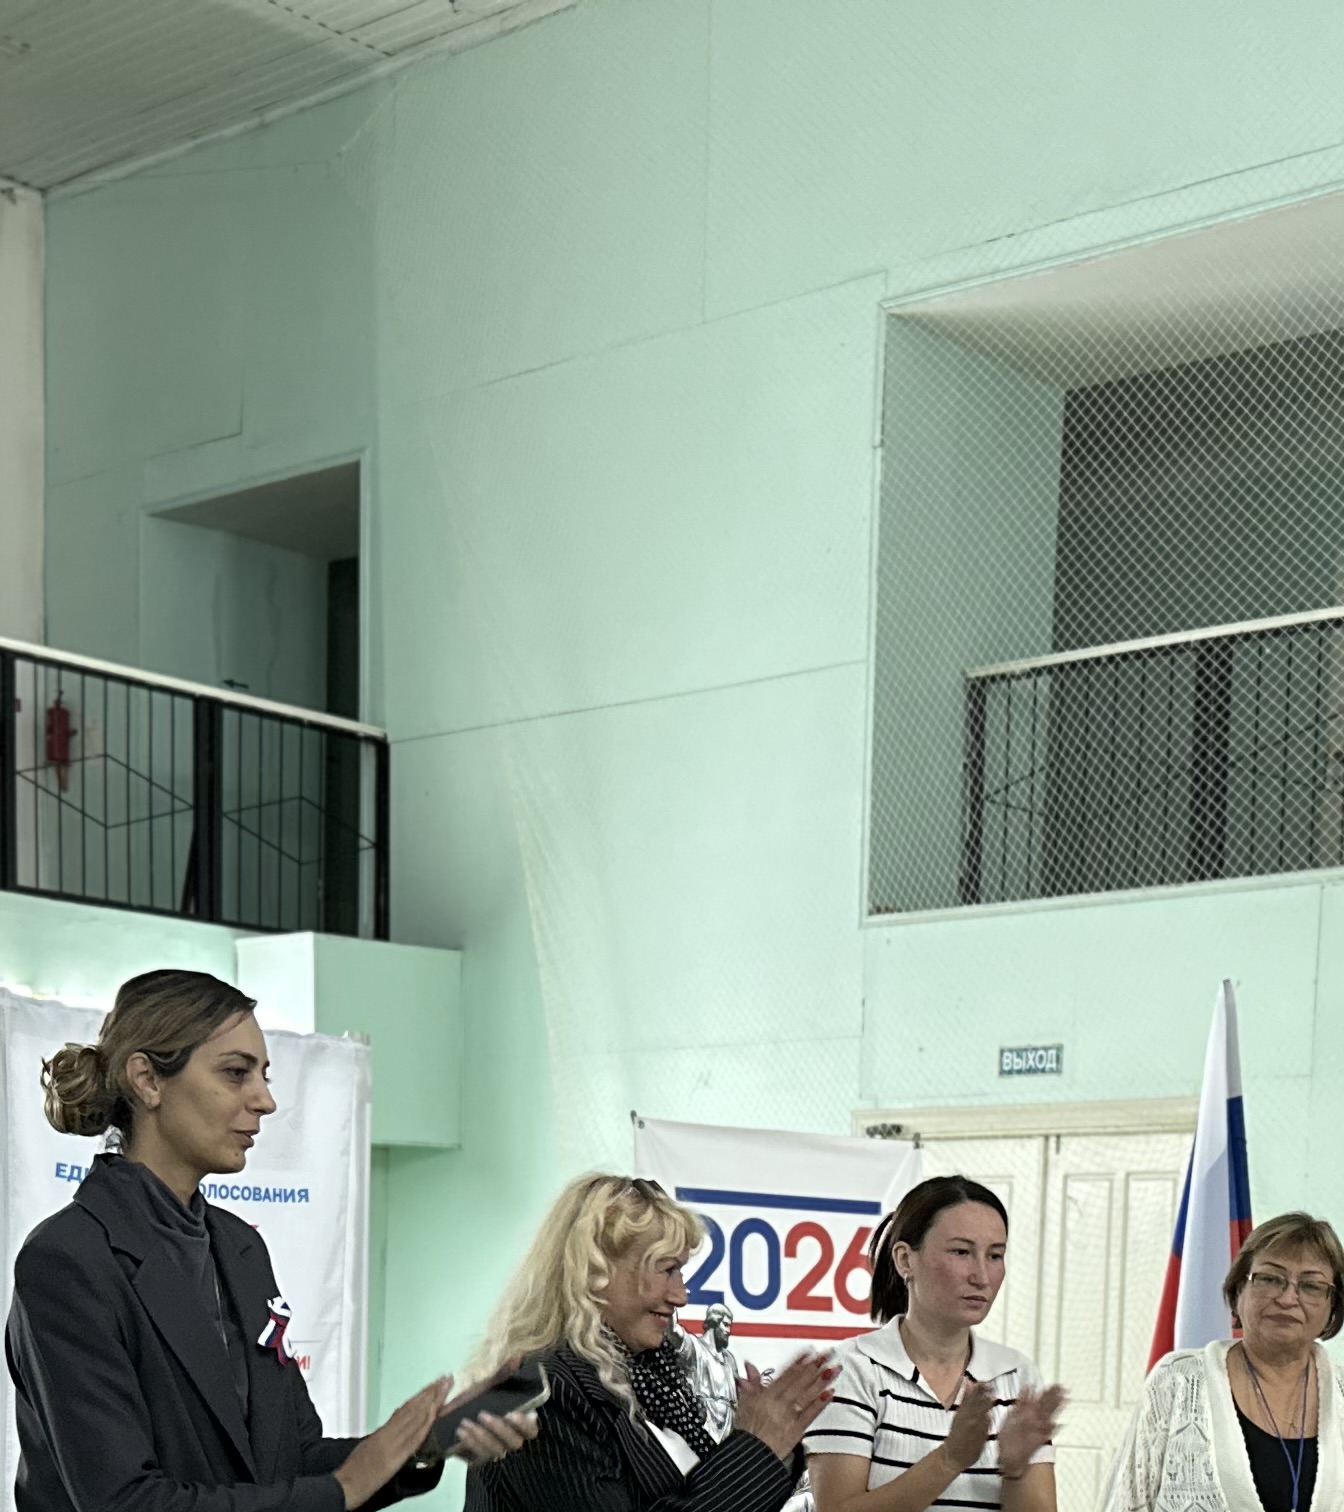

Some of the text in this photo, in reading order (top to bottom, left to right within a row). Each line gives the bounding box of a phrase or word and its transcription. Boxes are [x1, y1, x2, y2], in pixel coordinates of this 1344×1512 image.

[1001, 1048, 1058, 1072] ВЫХОД
[199, 1183, 311, 1204] ОЛОСОВАНИЯ
[687, 1214, 874, 1315] 2026
